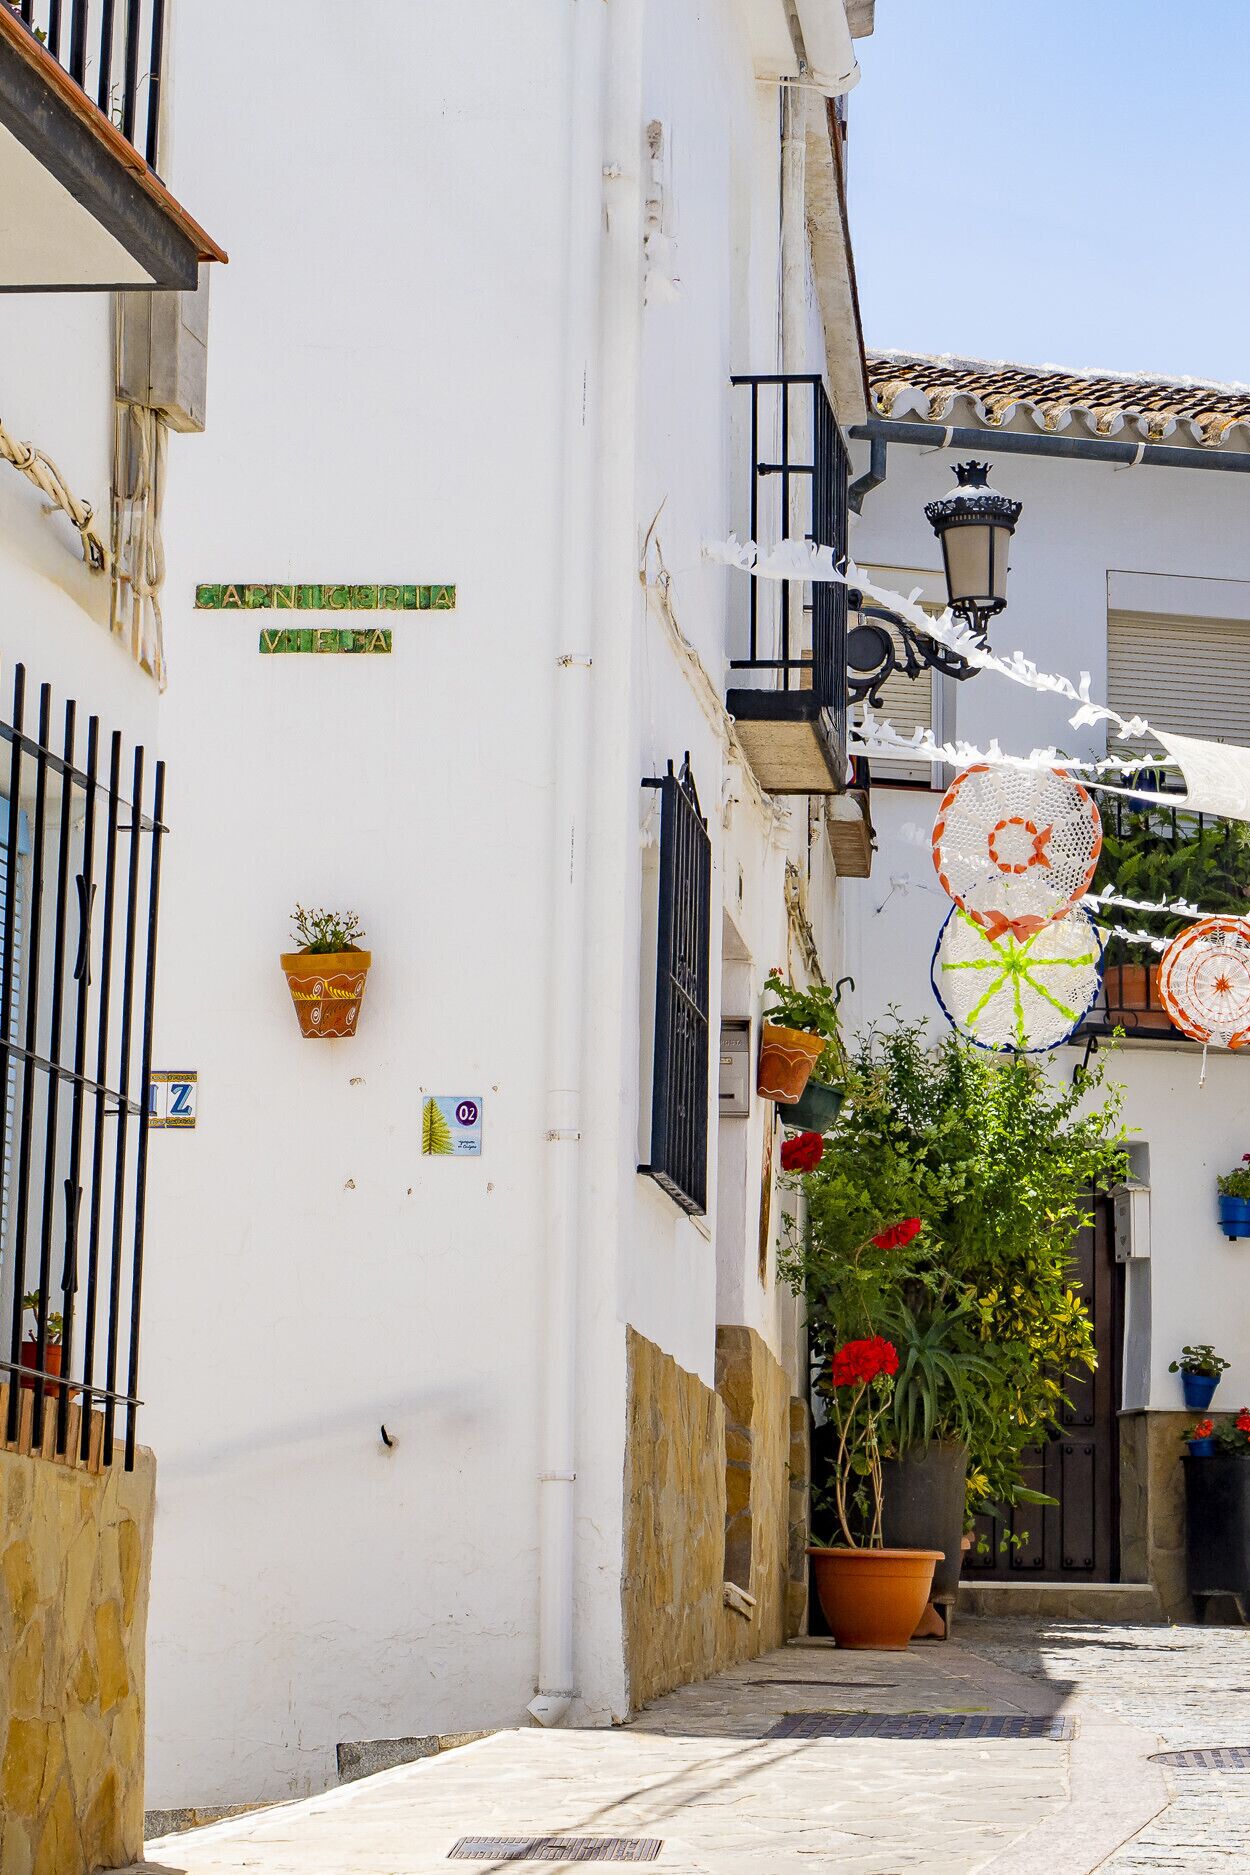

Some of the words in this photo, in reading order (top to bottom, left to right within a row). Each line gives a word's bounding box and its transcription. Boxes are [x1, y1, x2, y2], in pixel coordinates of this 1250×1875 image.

[196, 584, 455, 609] CARNICERIA
[261, 628, 389, 653] VIEJA
[459, 1105, 475, 1121] 02
